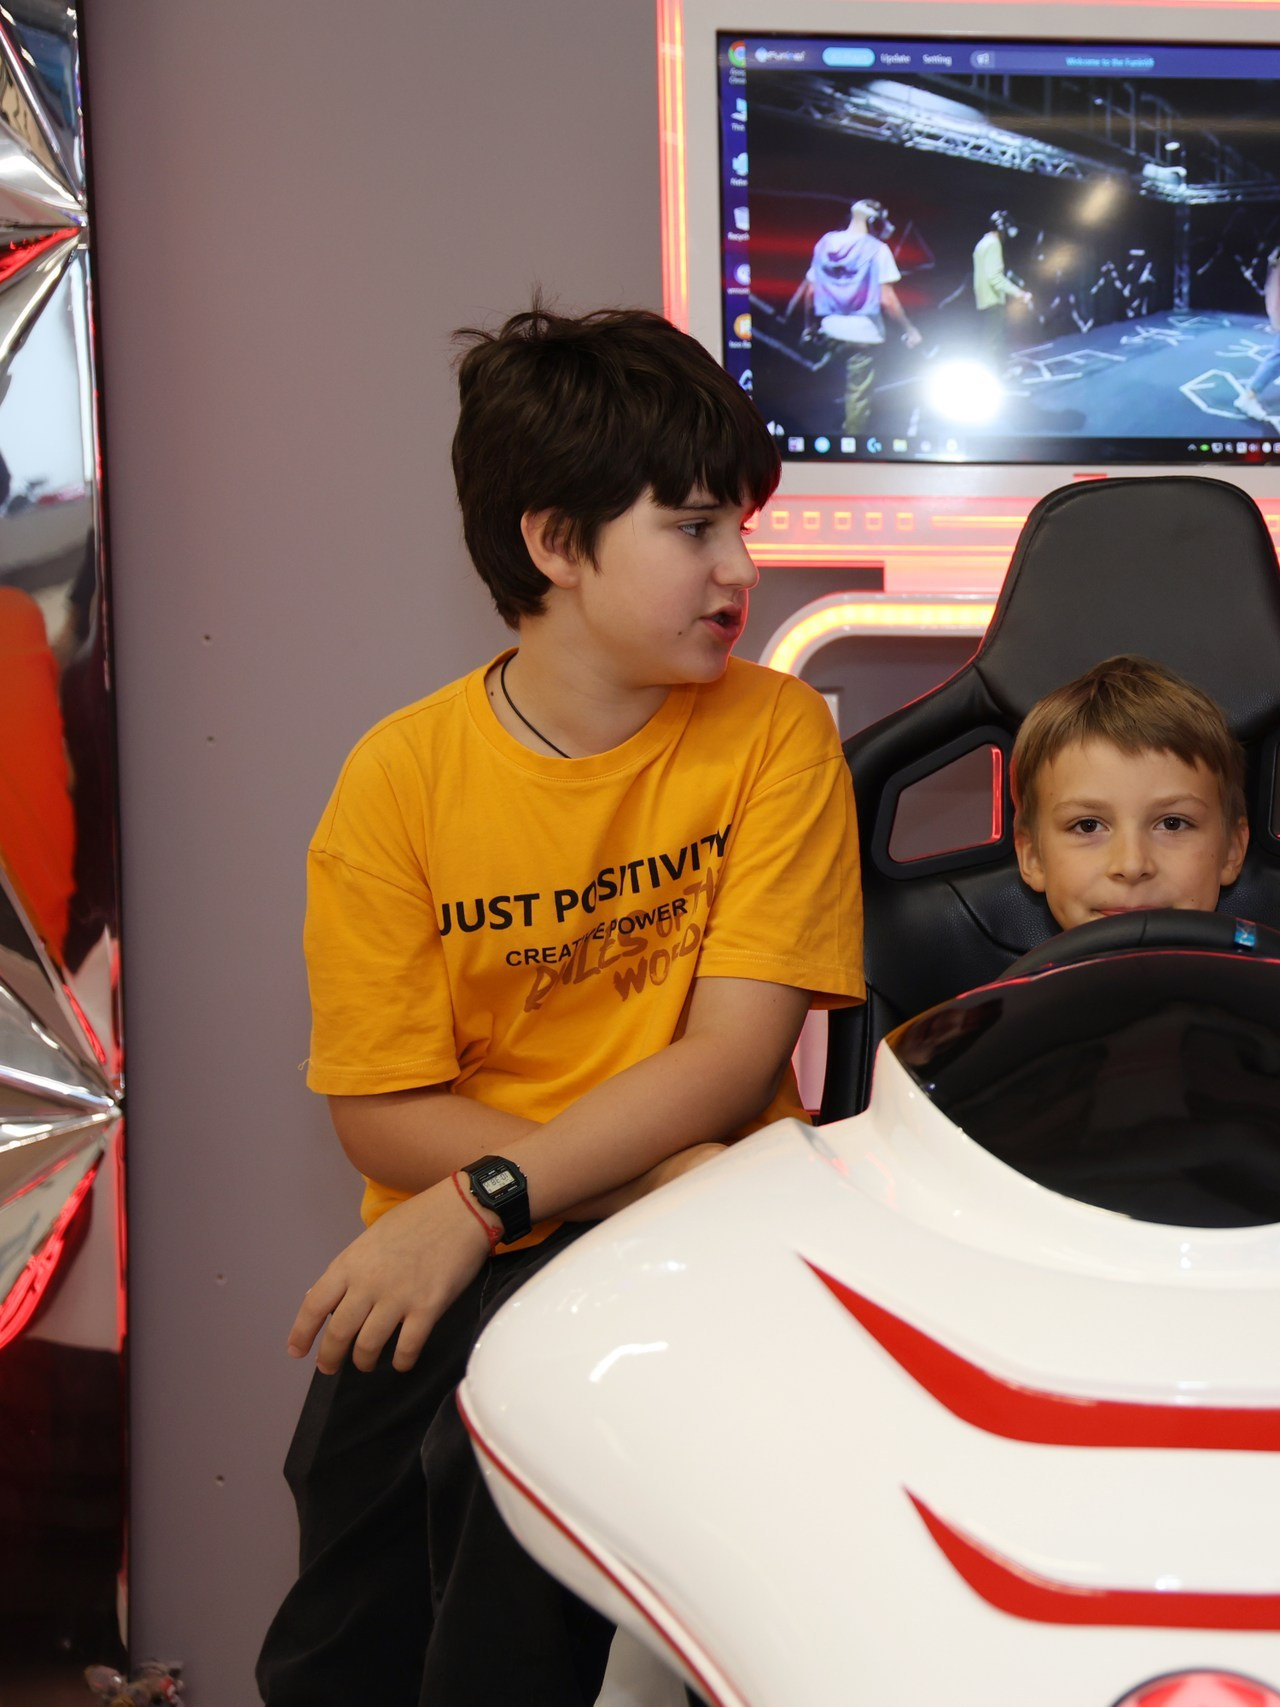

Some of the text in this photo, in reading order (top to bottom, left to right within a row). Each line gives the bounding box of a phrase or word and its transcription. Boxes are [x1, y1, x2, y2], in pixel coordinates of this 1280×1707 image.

[880, 53, 911, 66] Update
[922, 53, 952, 67] Setting
[440, 824, 732, 936] JUST POSITIVITY
[609, 897, 688, 935] POWER
